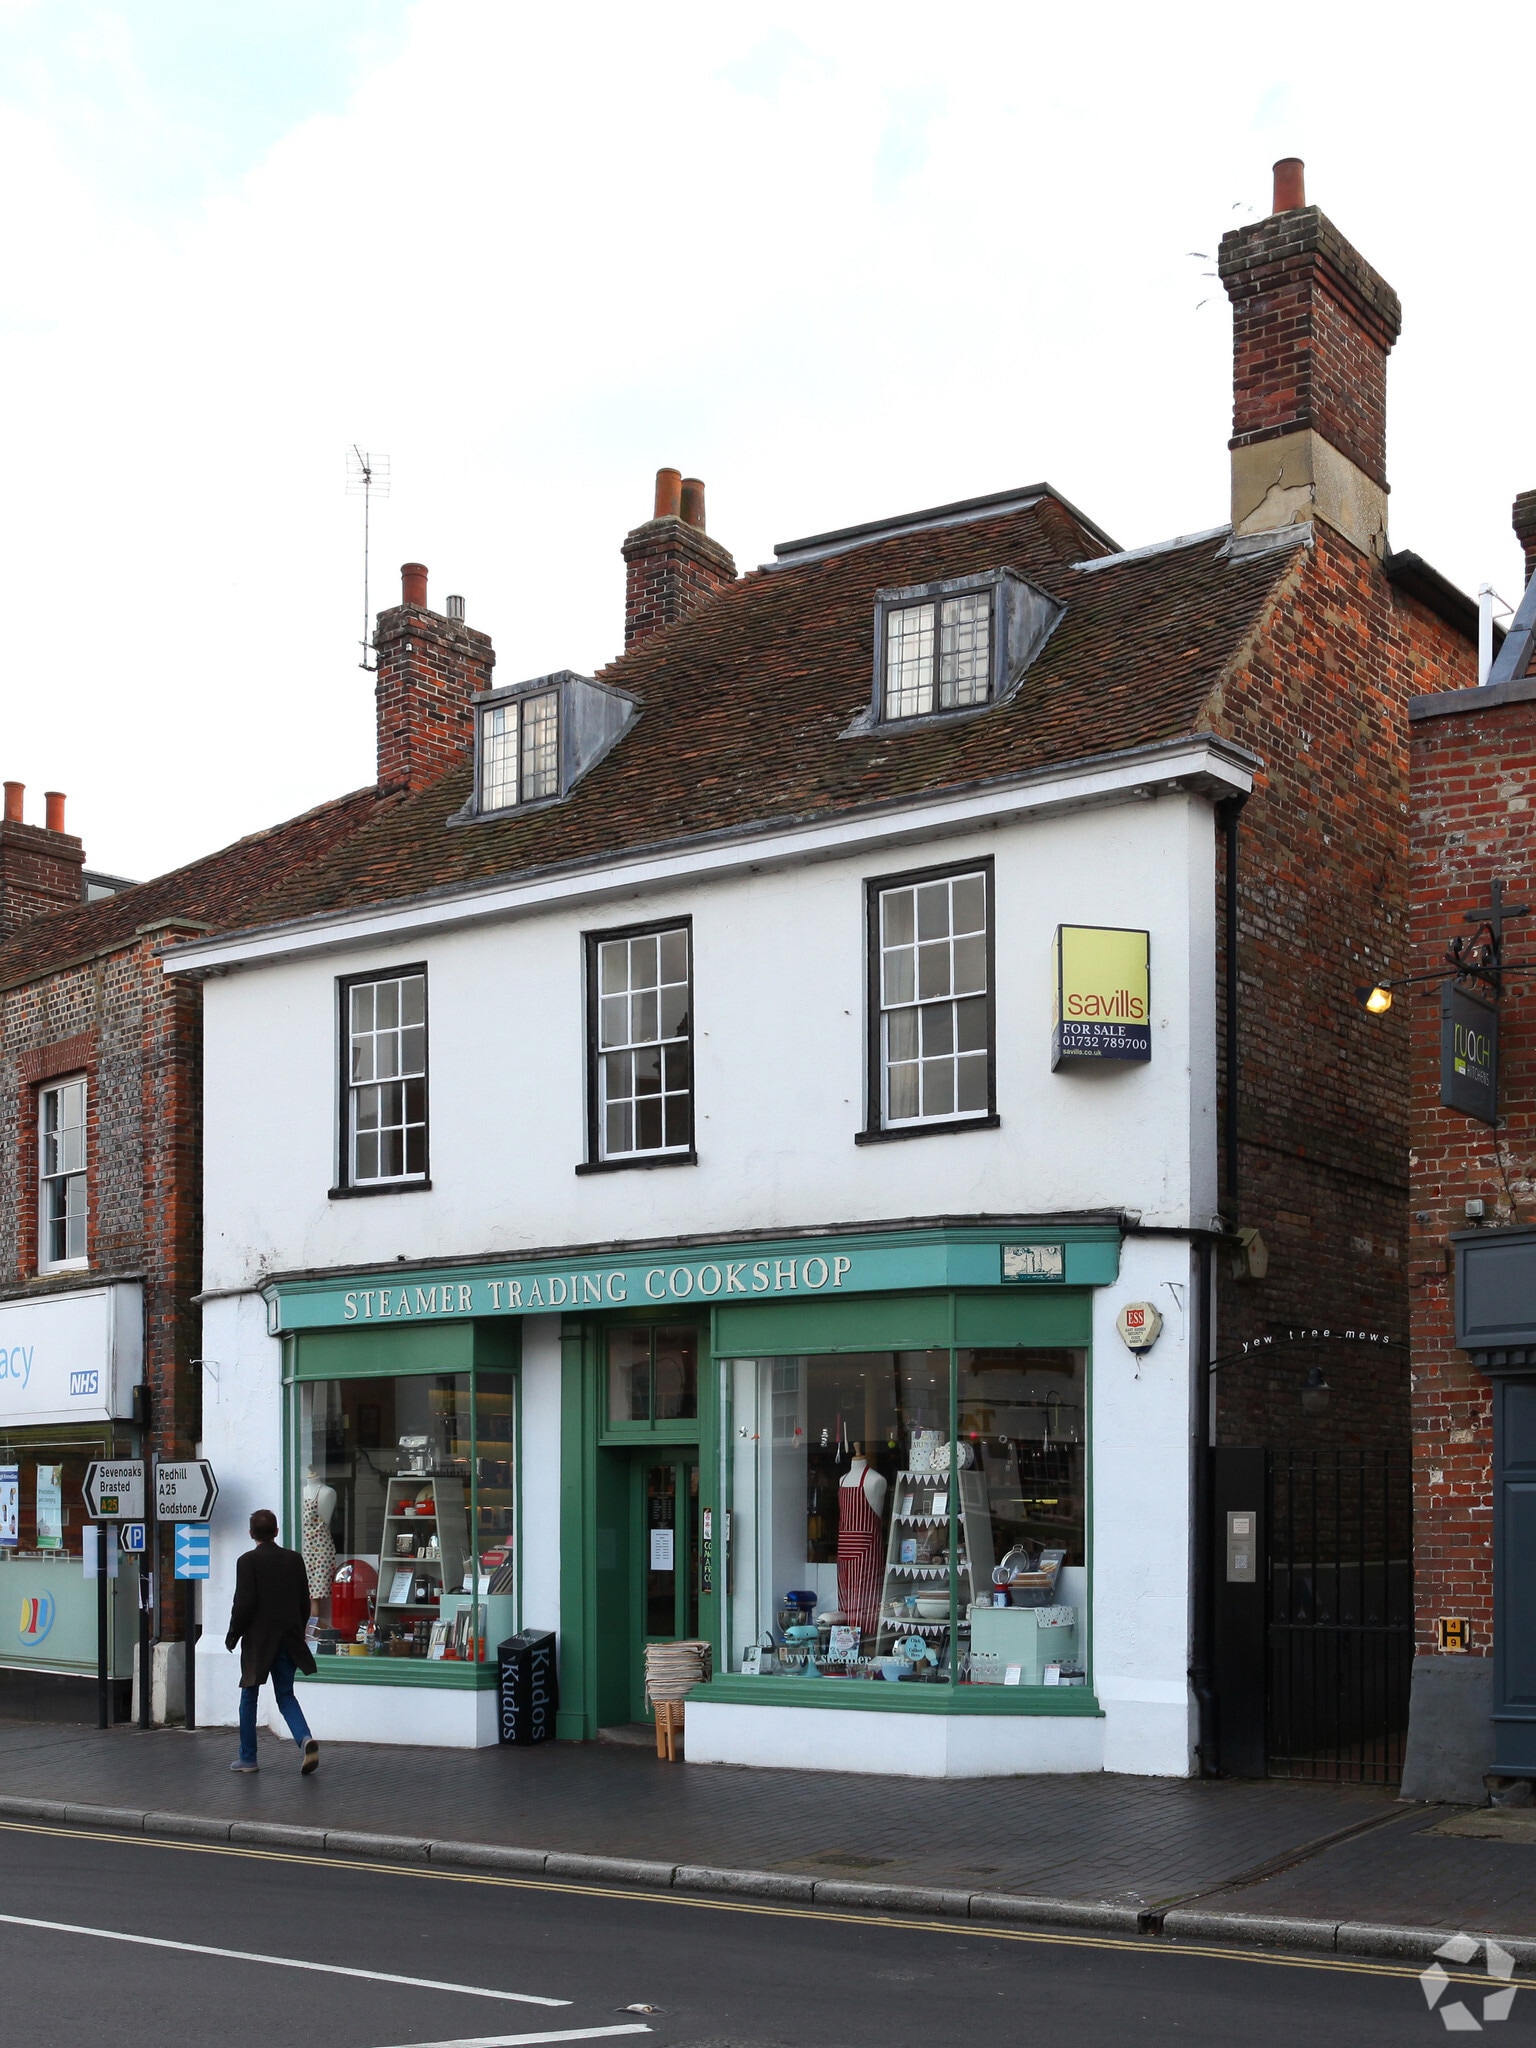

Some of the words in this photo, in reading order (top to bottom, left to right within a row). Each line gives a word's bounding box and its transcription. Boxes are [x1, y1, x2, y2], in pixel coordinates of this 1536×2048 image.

[1068, 990, 1144, 1019] savills
[1063, 1023, 1091, 1035] FOR
[1094, 1024, 1126, 1037] SALE
[1062, 1035, 1099, 1047] 01732
[1103, 1037, 1147, 1050] 789700
[1062, 1048, 1102, 1057] savills.co.uk
[343, 1284, 473, 1320] STEAMER
[488, 1271, 628, 1310] TRADING
[645, 1255, 852, 1299] COOKSHOP
[1127, 1311, 1144, 1325] ESS
[1242, 1335, 1273, 1353] yew
[1289, 1329, 1330, 1340] tree
[1345, 1329, 1390, 1344] mews
[70, 1371, 98, 1394] NHS
[99, 1466, 142, 1478] Sevenoaks
[159, 1468, 187, 1481] Redhill
[100, 1480, 131, 1492] Brasted
[159, 1483, 177, 1496] A25
[101, 1499, 118, 1511] A25
[159, 1502, 198, 1515] Godstone
[133, 1529, 142, 1547] P
[1451, 1621, 1456, 1629] 4
[1451, 1638, 1457, 1646] 9
[531, 1646, 550, 1739] Kudos
[501, 1662, 520, 1740] Kudos
